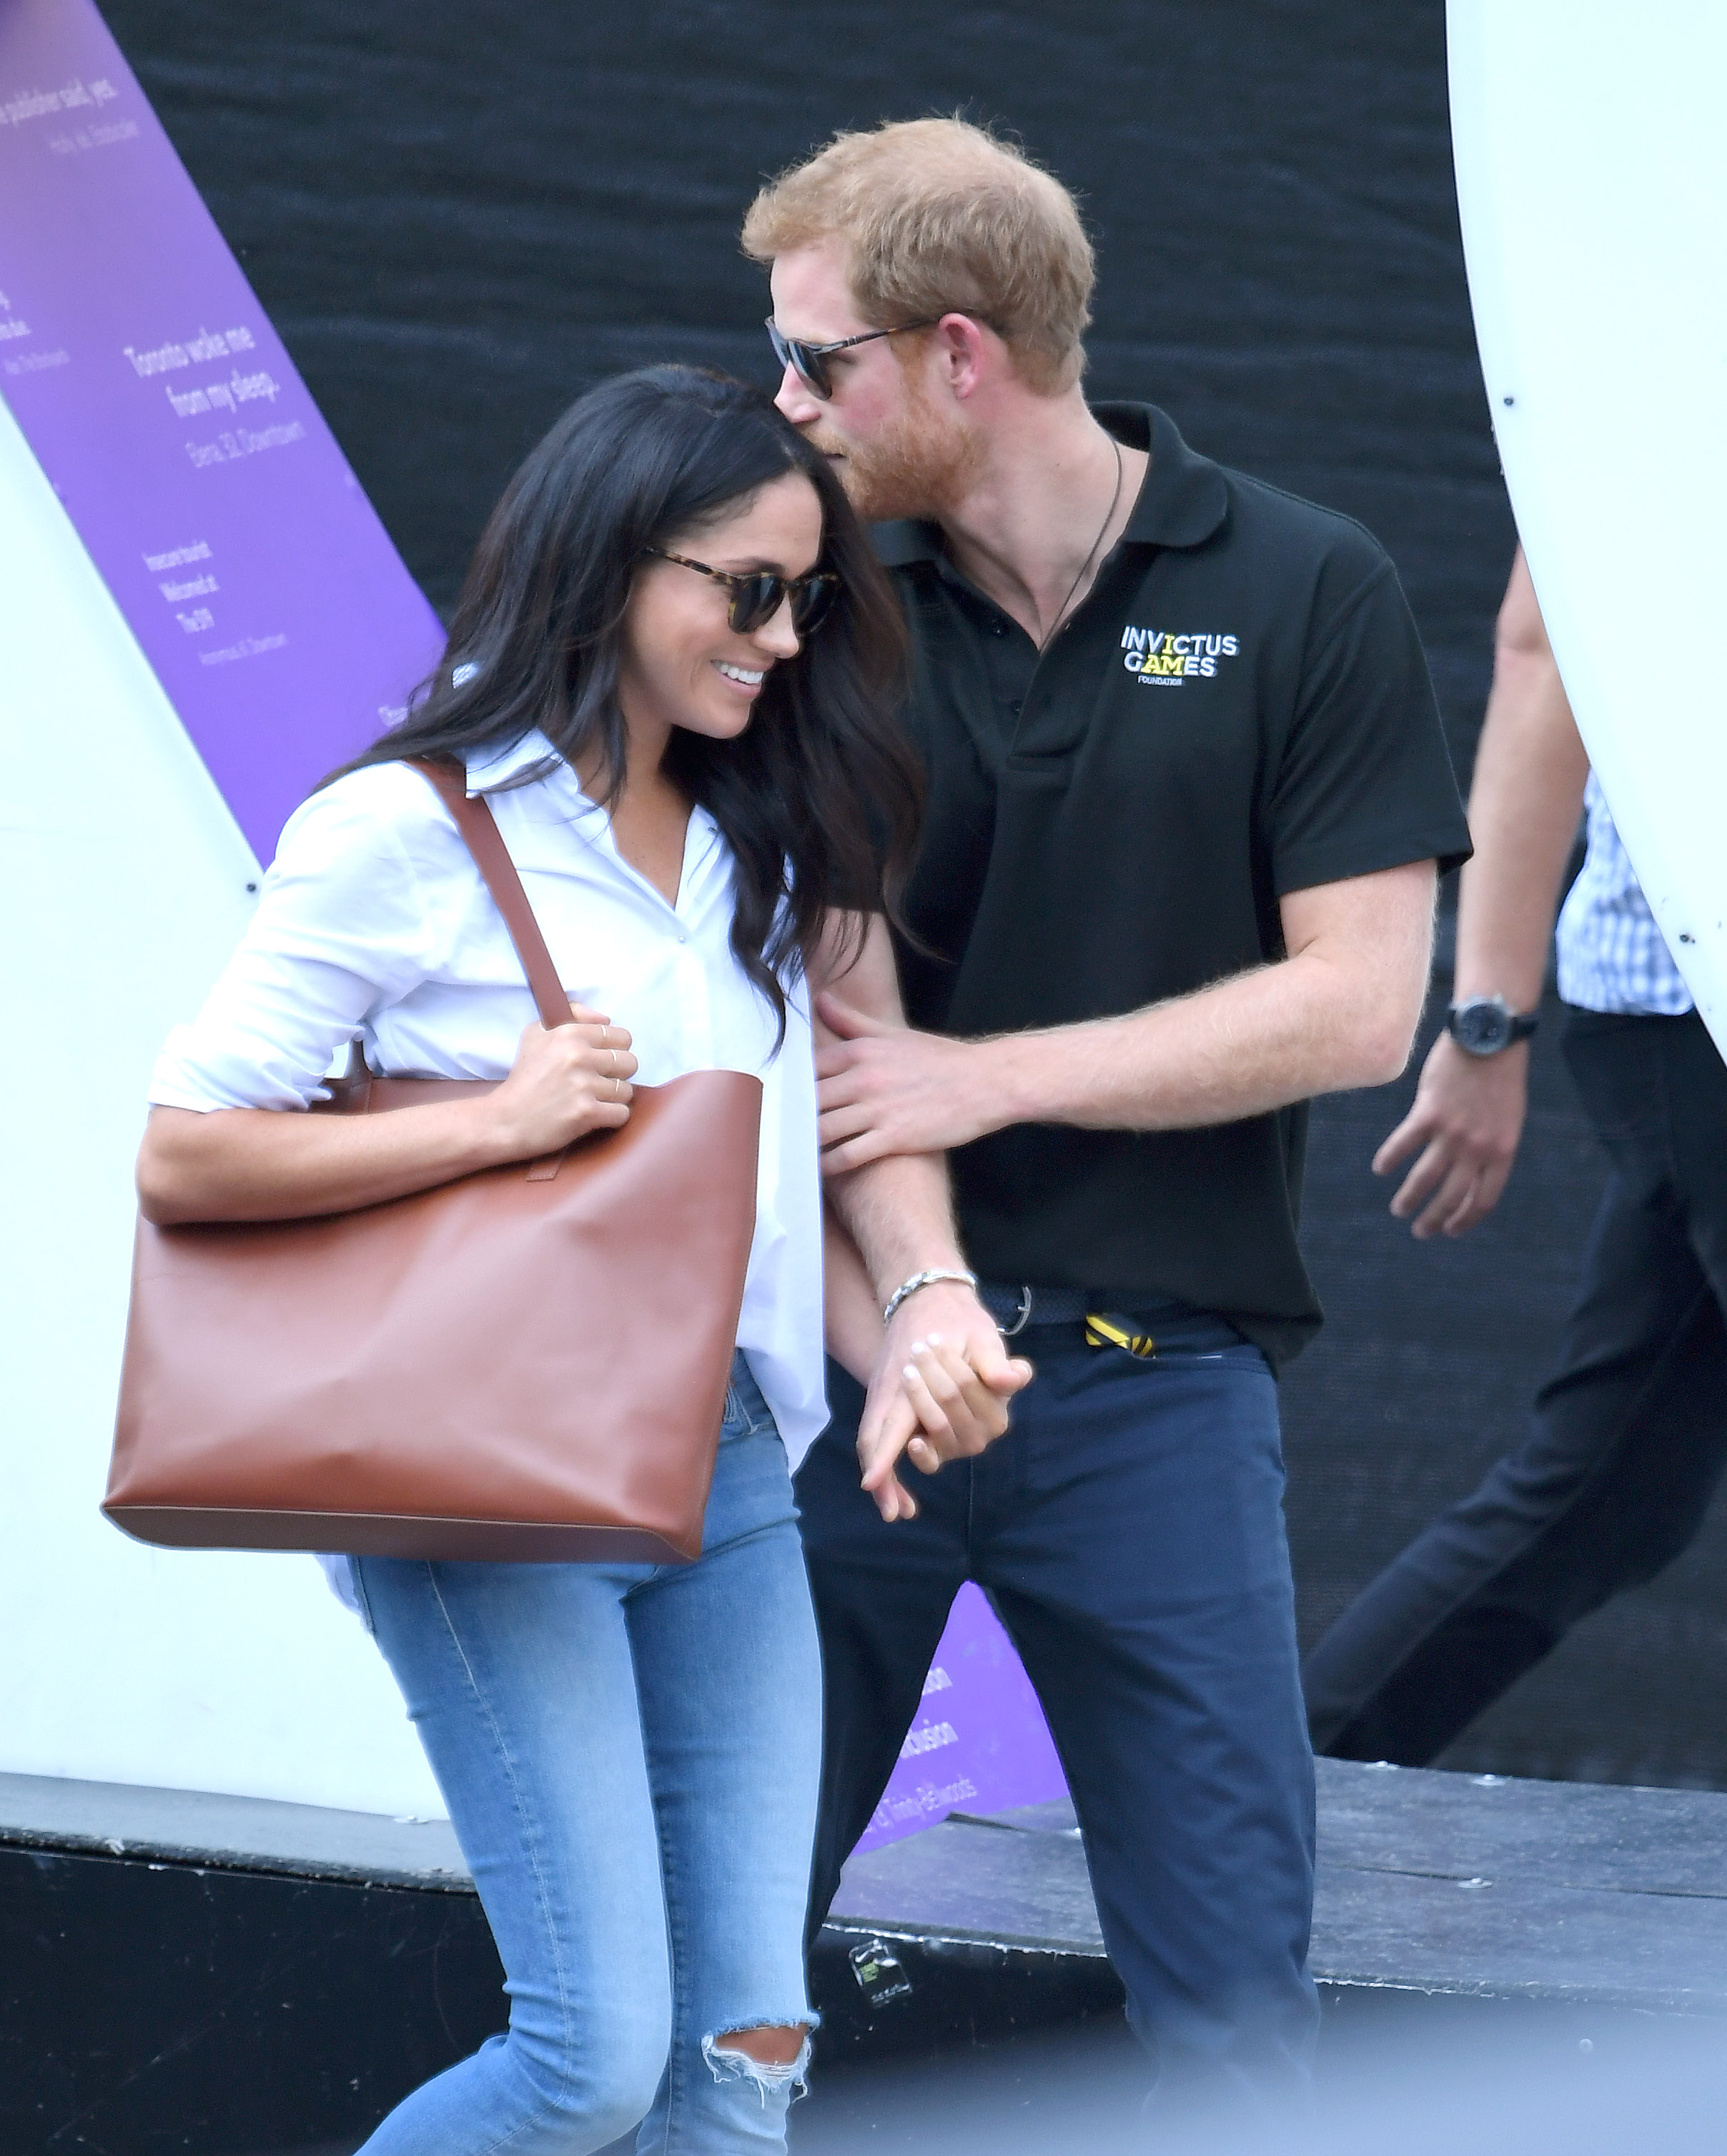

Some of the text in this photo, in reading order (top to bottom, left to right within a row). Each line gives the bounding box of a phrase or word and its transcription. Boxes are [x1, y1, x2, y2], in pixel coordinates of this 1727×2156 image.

[123, 326, 256, 377] Toronto woke me
[165, 368, 280, 417] from my sleep.
[1120, 625, 1238, 656] INVICTUS
[1124, 651, 1217, 677] GAMES
[1138, 676, 1184, 686] FOUNDATION
